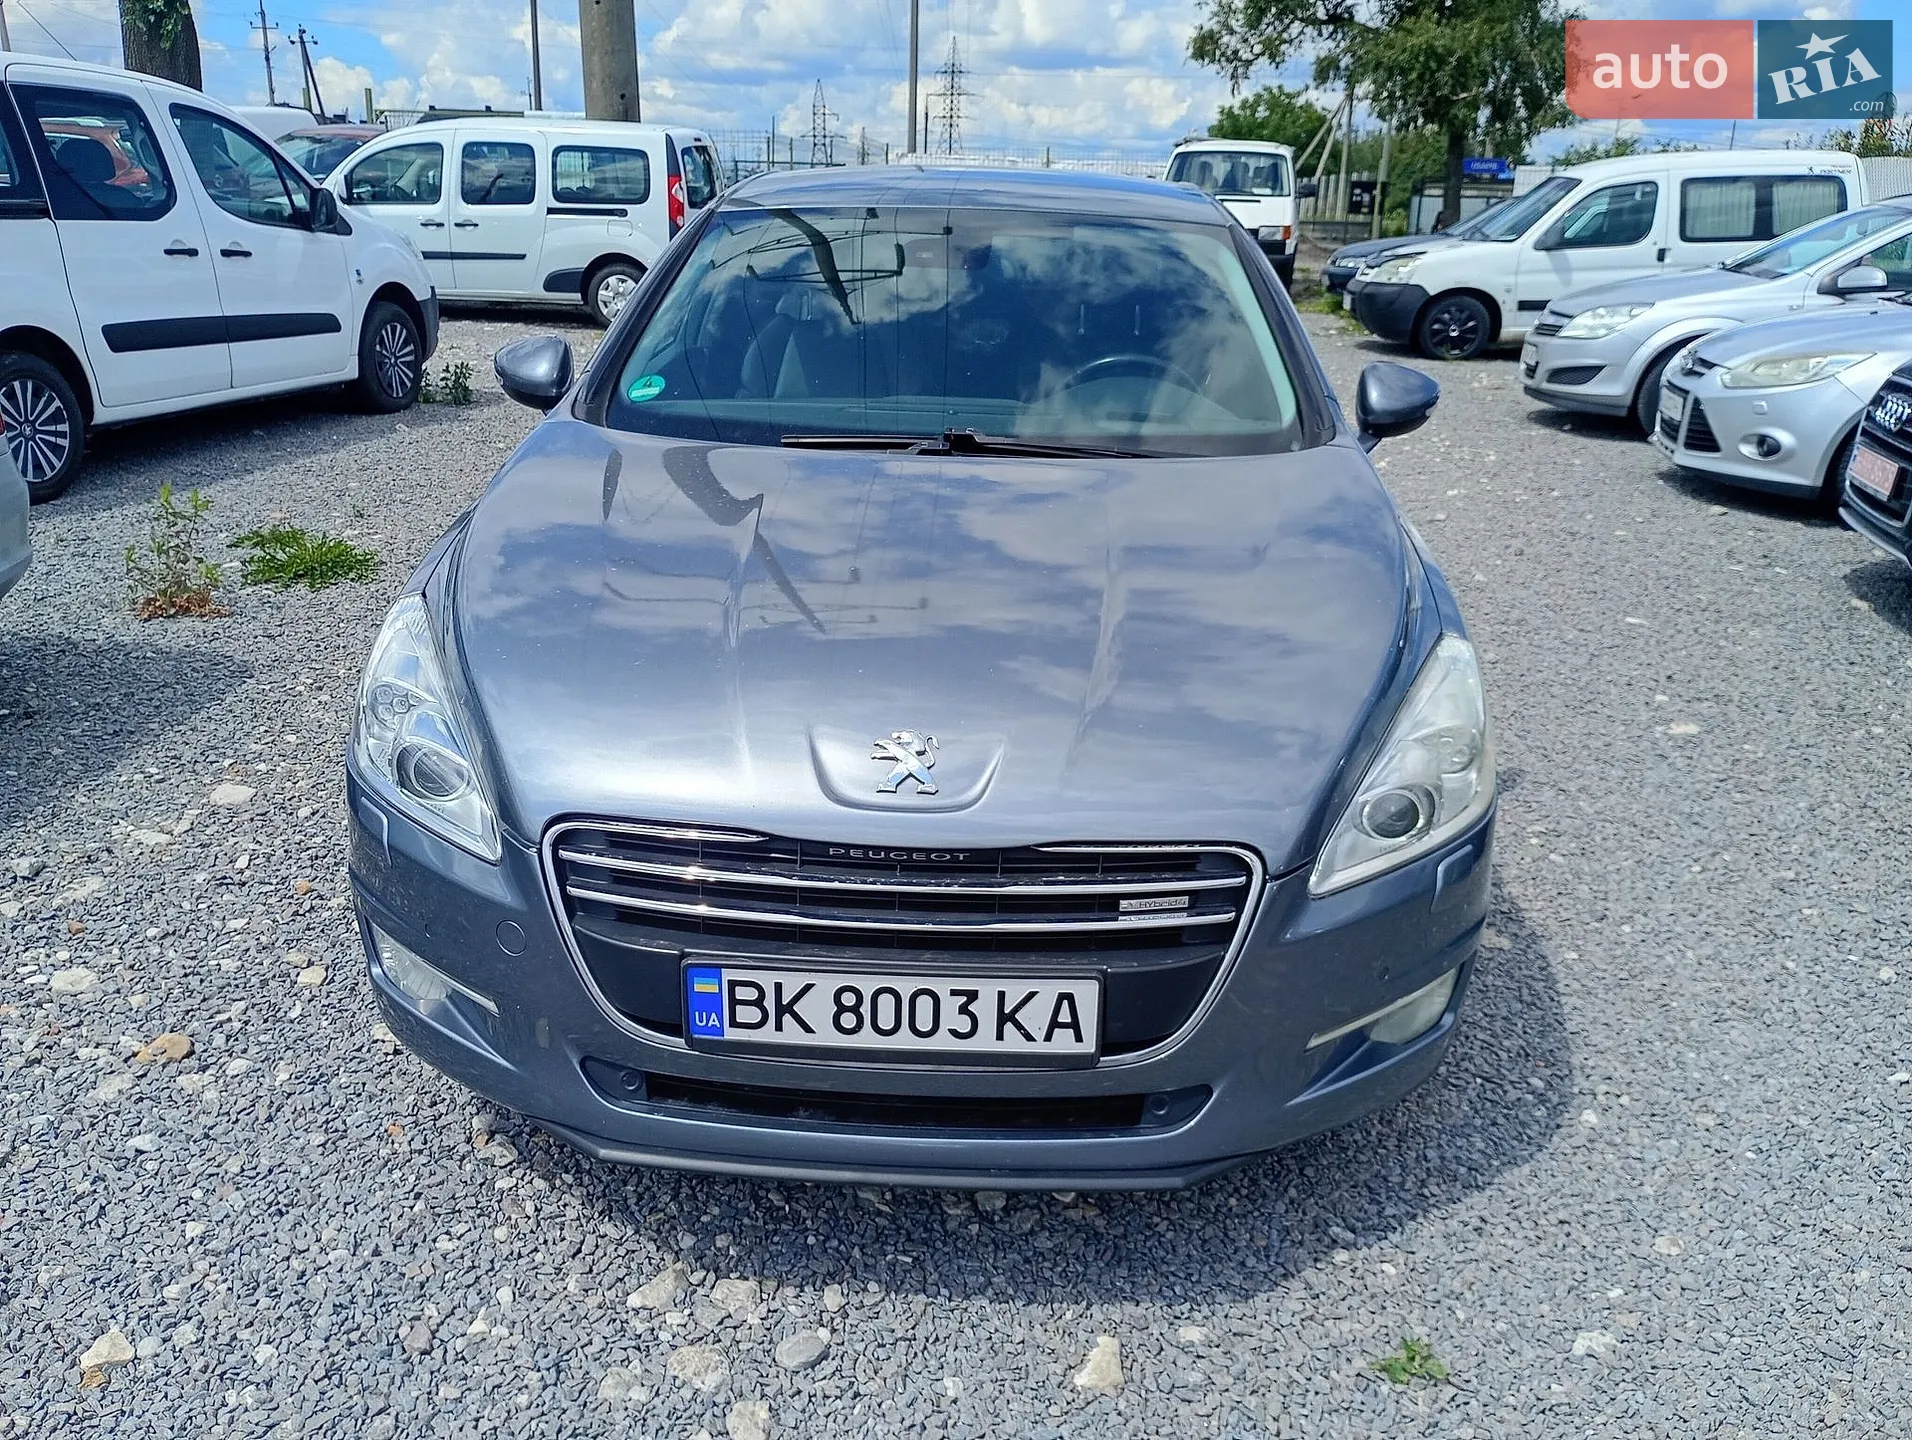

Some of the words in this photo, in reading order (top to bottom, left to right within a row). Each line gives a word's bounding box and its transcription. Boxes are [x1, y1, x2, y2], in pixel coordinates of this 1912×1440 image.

[829, 848, 971, 861] PEUGEOT
[695, 1011, 721, 1028] UA
[727, 979, 817, 1034] BK
[831, 984, 980, 1040] 8003
[994, 990, 1084, 1044] KA
